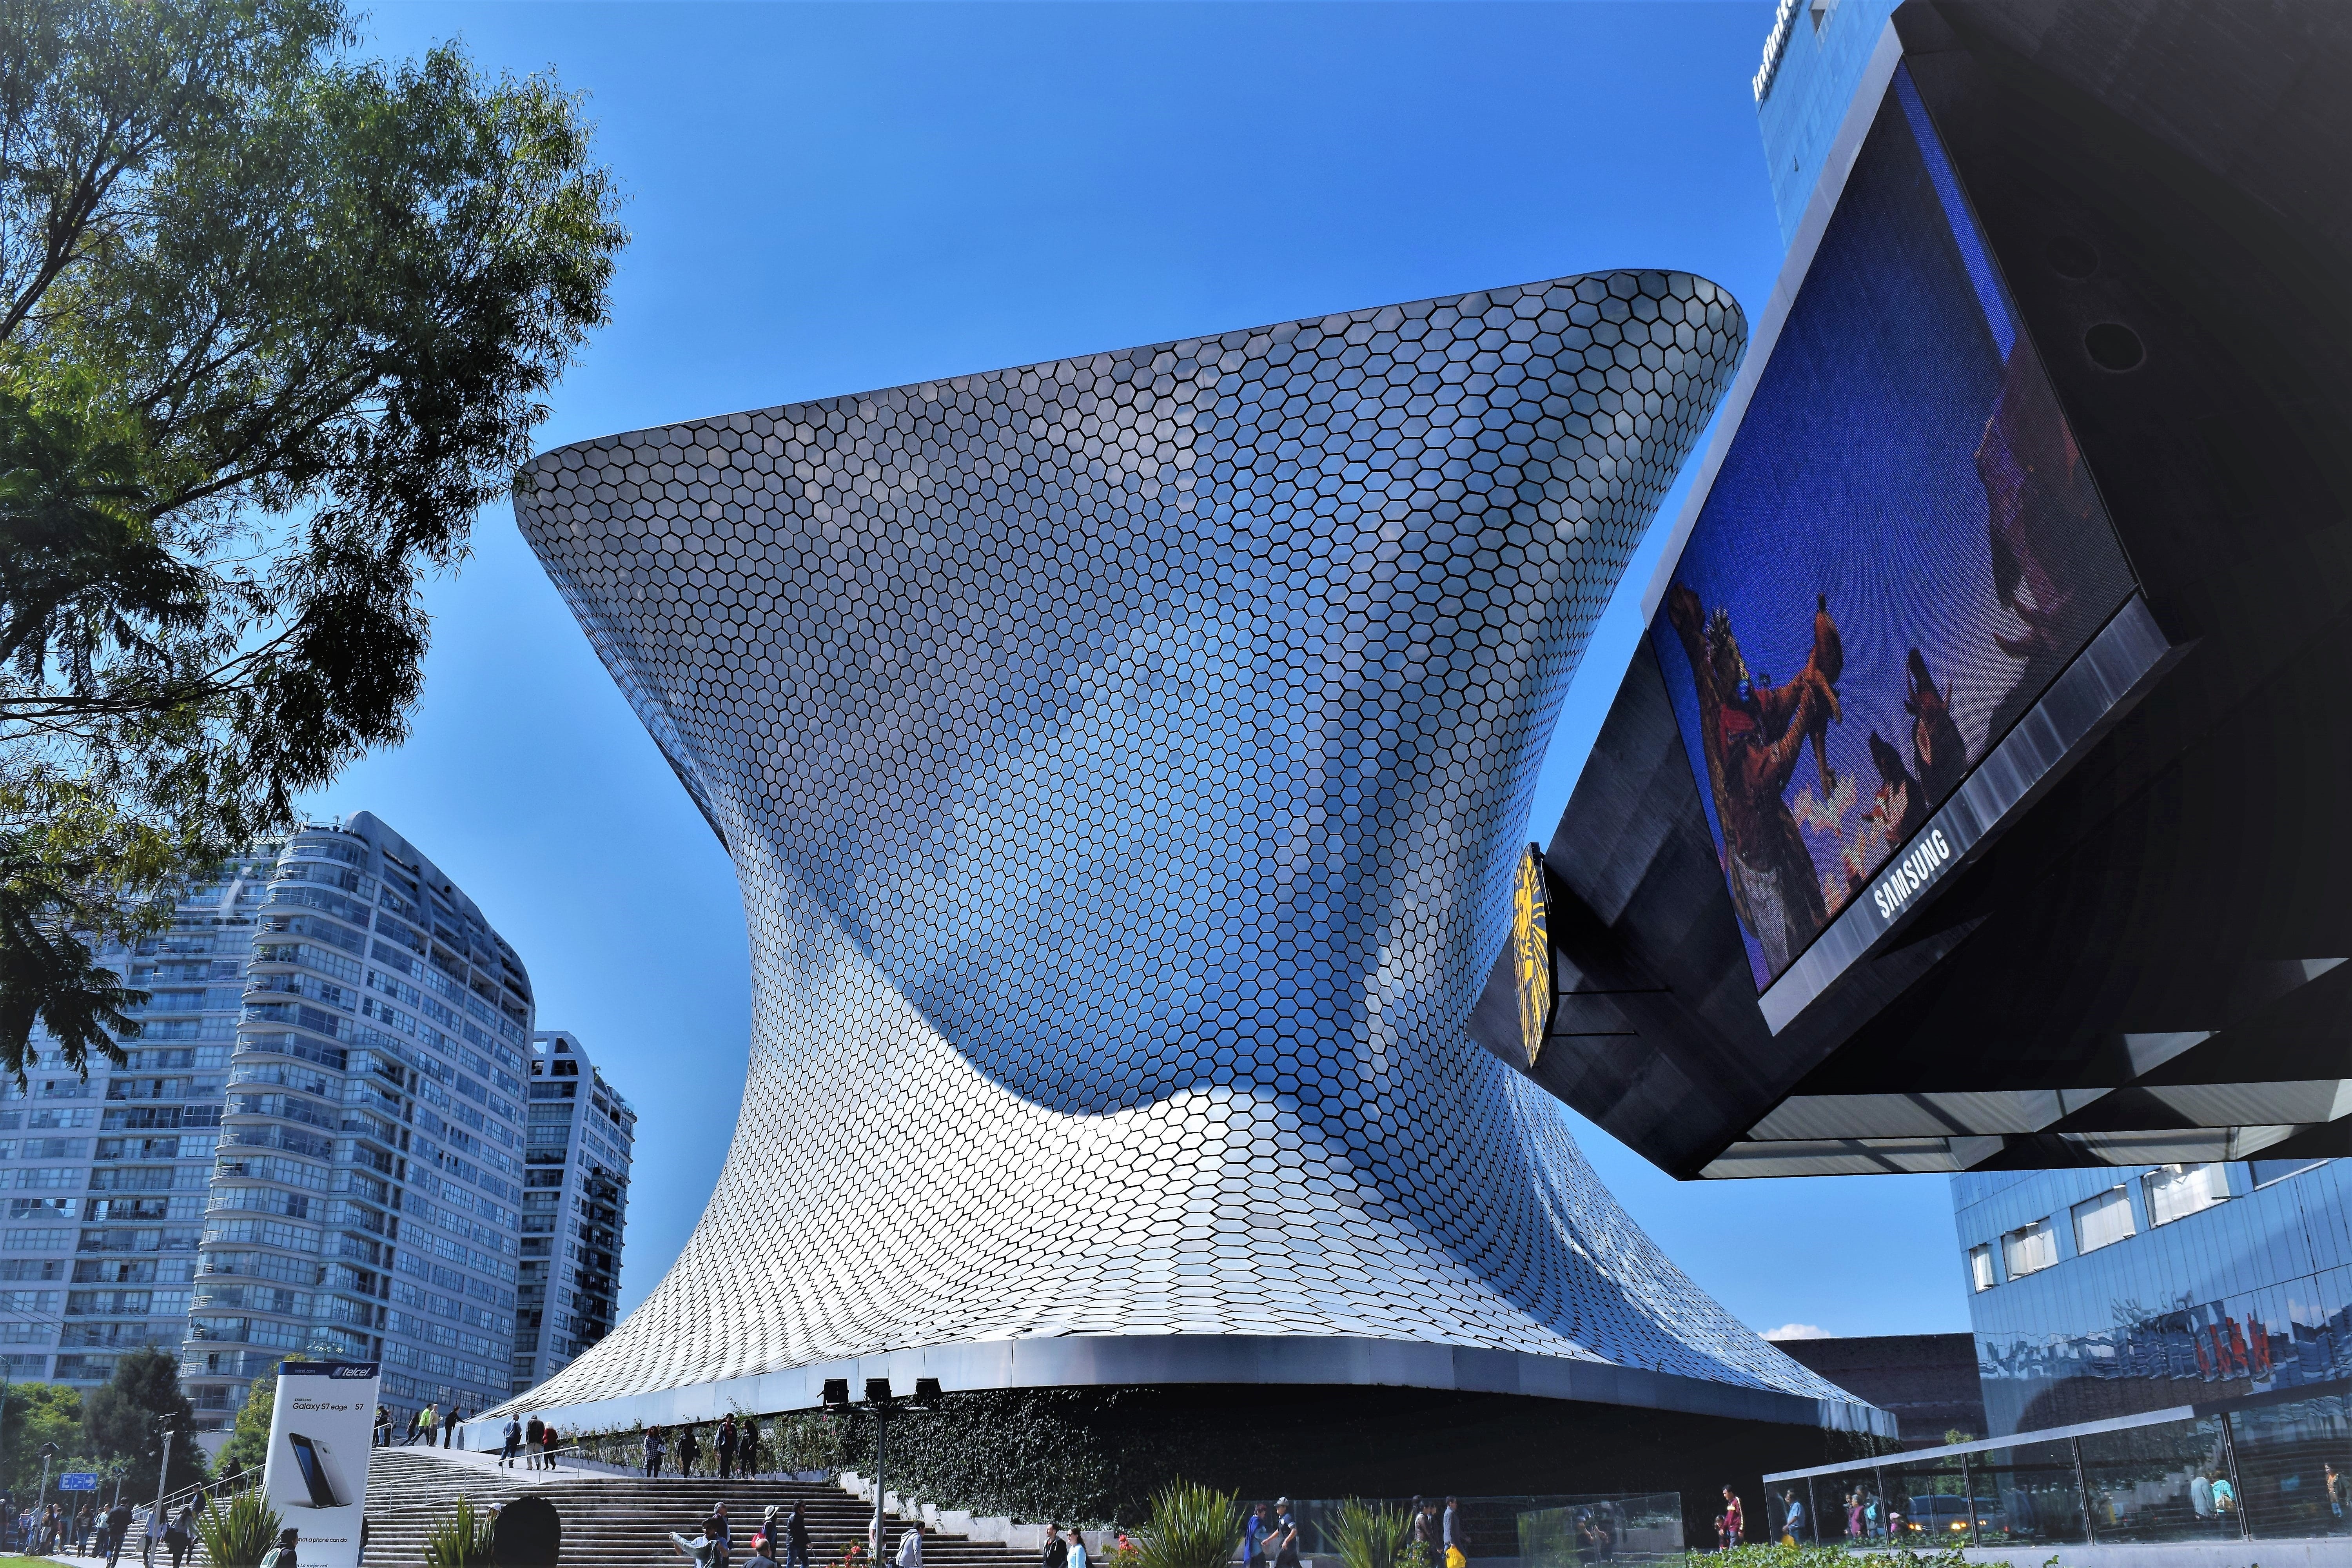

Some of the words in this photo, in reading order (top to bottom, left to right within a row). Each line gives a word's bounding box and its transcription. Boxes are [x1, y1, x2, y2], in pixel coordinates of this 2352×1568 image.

[1874, 829, 1949, 918] SAMSUNG
[342, 1367, 371, 1376] telcel
[293, 1403, 320, 1411] Galaxy
[62, 1475, 71, 1488] E
